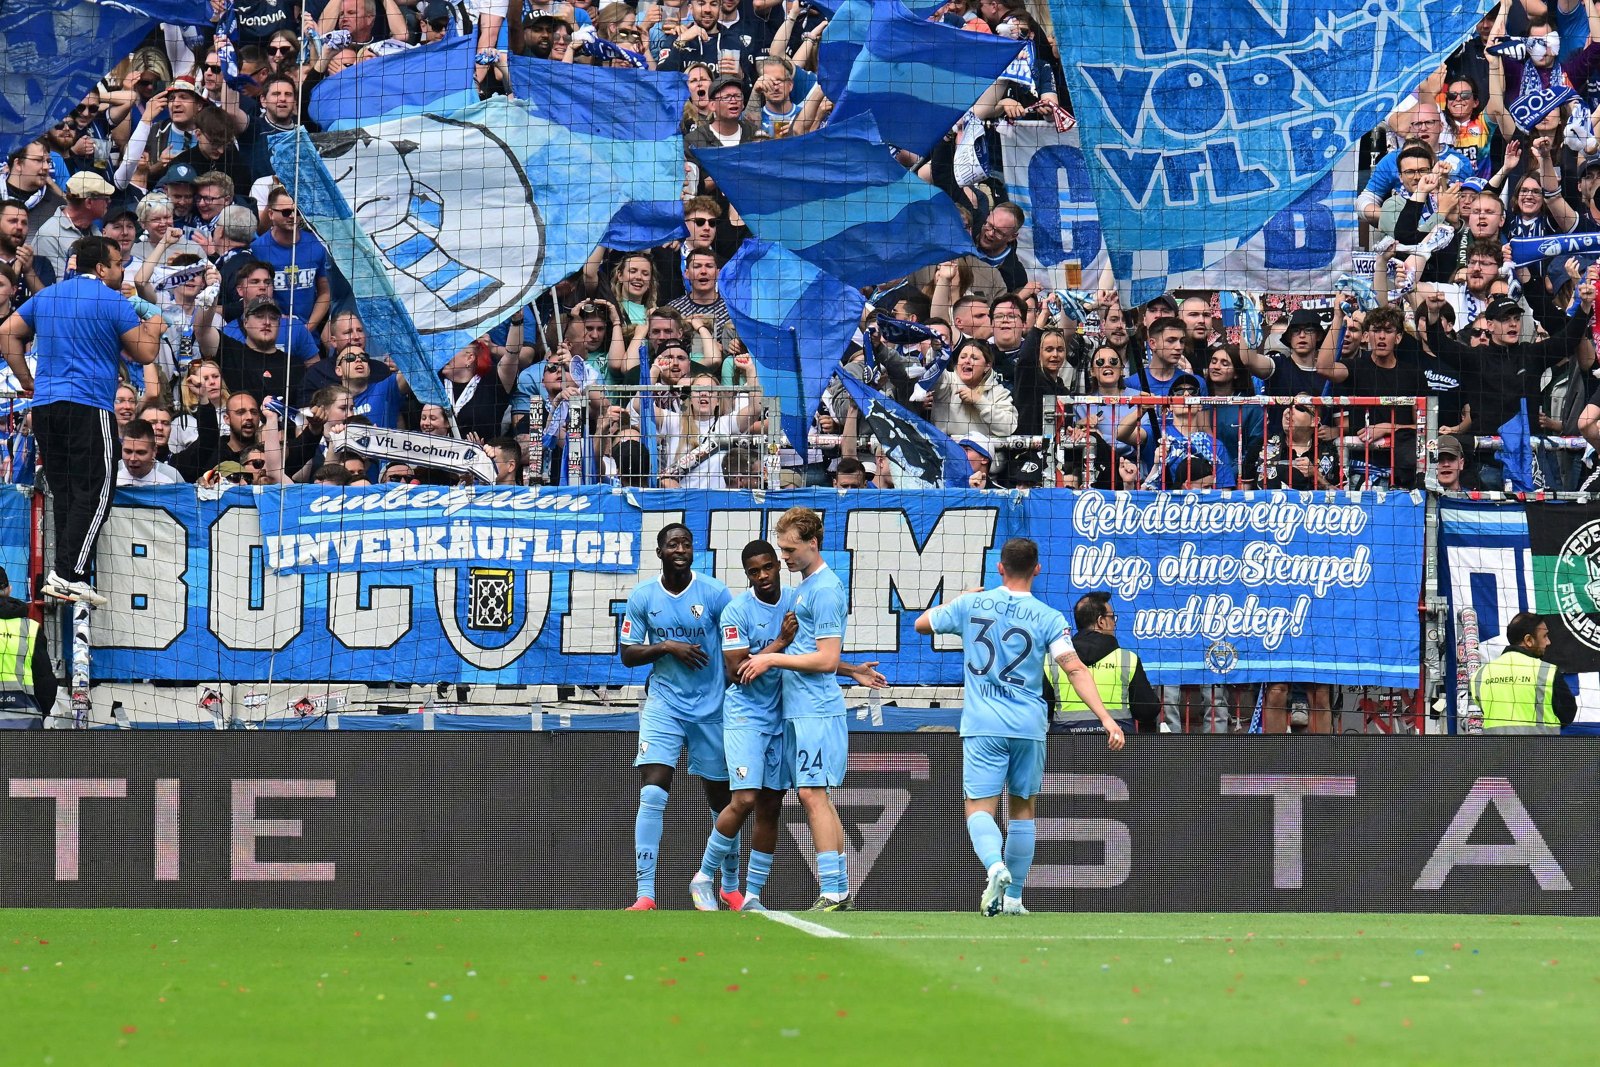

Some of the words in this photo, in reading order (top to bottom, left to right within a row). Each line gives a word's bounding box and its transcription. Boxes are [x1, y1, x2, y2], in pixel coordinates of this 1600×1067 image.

[375, 436, 398, 449] VfL
[402, 441, 460, 460] Bochum
[1073, 491, 1142, 540] Geh
[1141, 491, 1248, 535] deinen
[1247, 491, 1368, 545] eig'nen
[266, 520, 634, 569] UNVERKÄUFLICH
[1070, 541, 1153, 601] Weg,
[1157, 541, 1242, 586] ohne
[1238, 540, 1372, 597] Stempel
[972, 596, 1040, 623] BOCHUM
[1133, 594, 1204, 640] und
[1202, 593, 1311, 651] Beleg!
[967, 616, 1033, 687] 32
[1485, 676, 1531, 685] ORDNER/-IN
[1069, 725, 1107, 734] www.u-ne
[798, 748, 823, 772] 24
[9, 778, 336, 881] TIE
